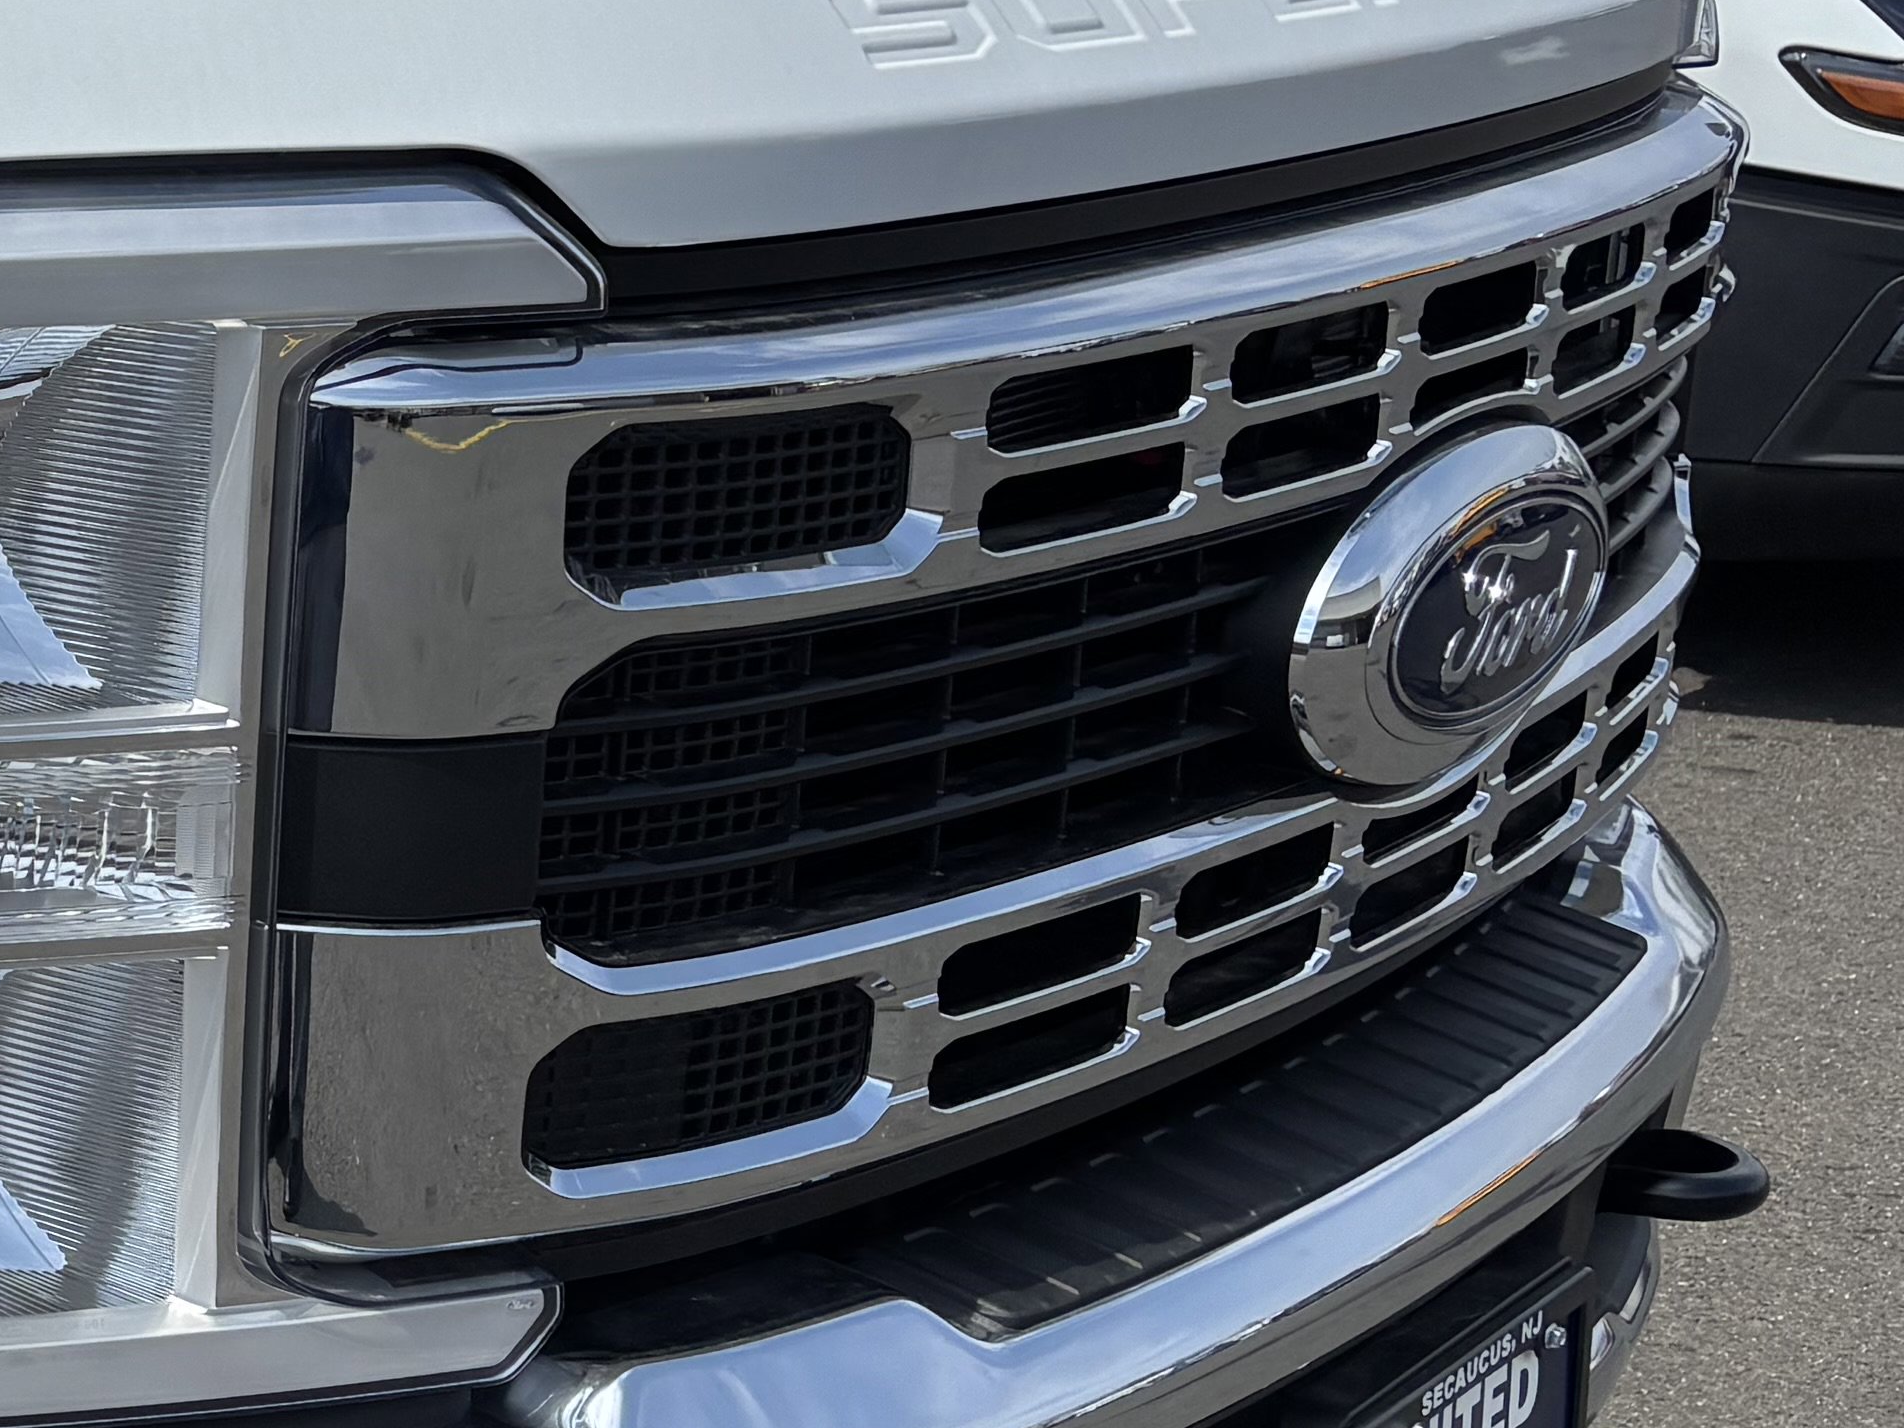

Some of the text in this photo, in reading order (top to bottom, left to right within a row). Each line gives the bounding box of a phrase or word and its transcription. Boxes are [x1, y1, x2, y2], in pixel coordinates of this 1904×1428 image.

[1440, 522, 1580, 695] Ford
[1421, 1309, 1544, 1417] SECAUCUS, NJ
